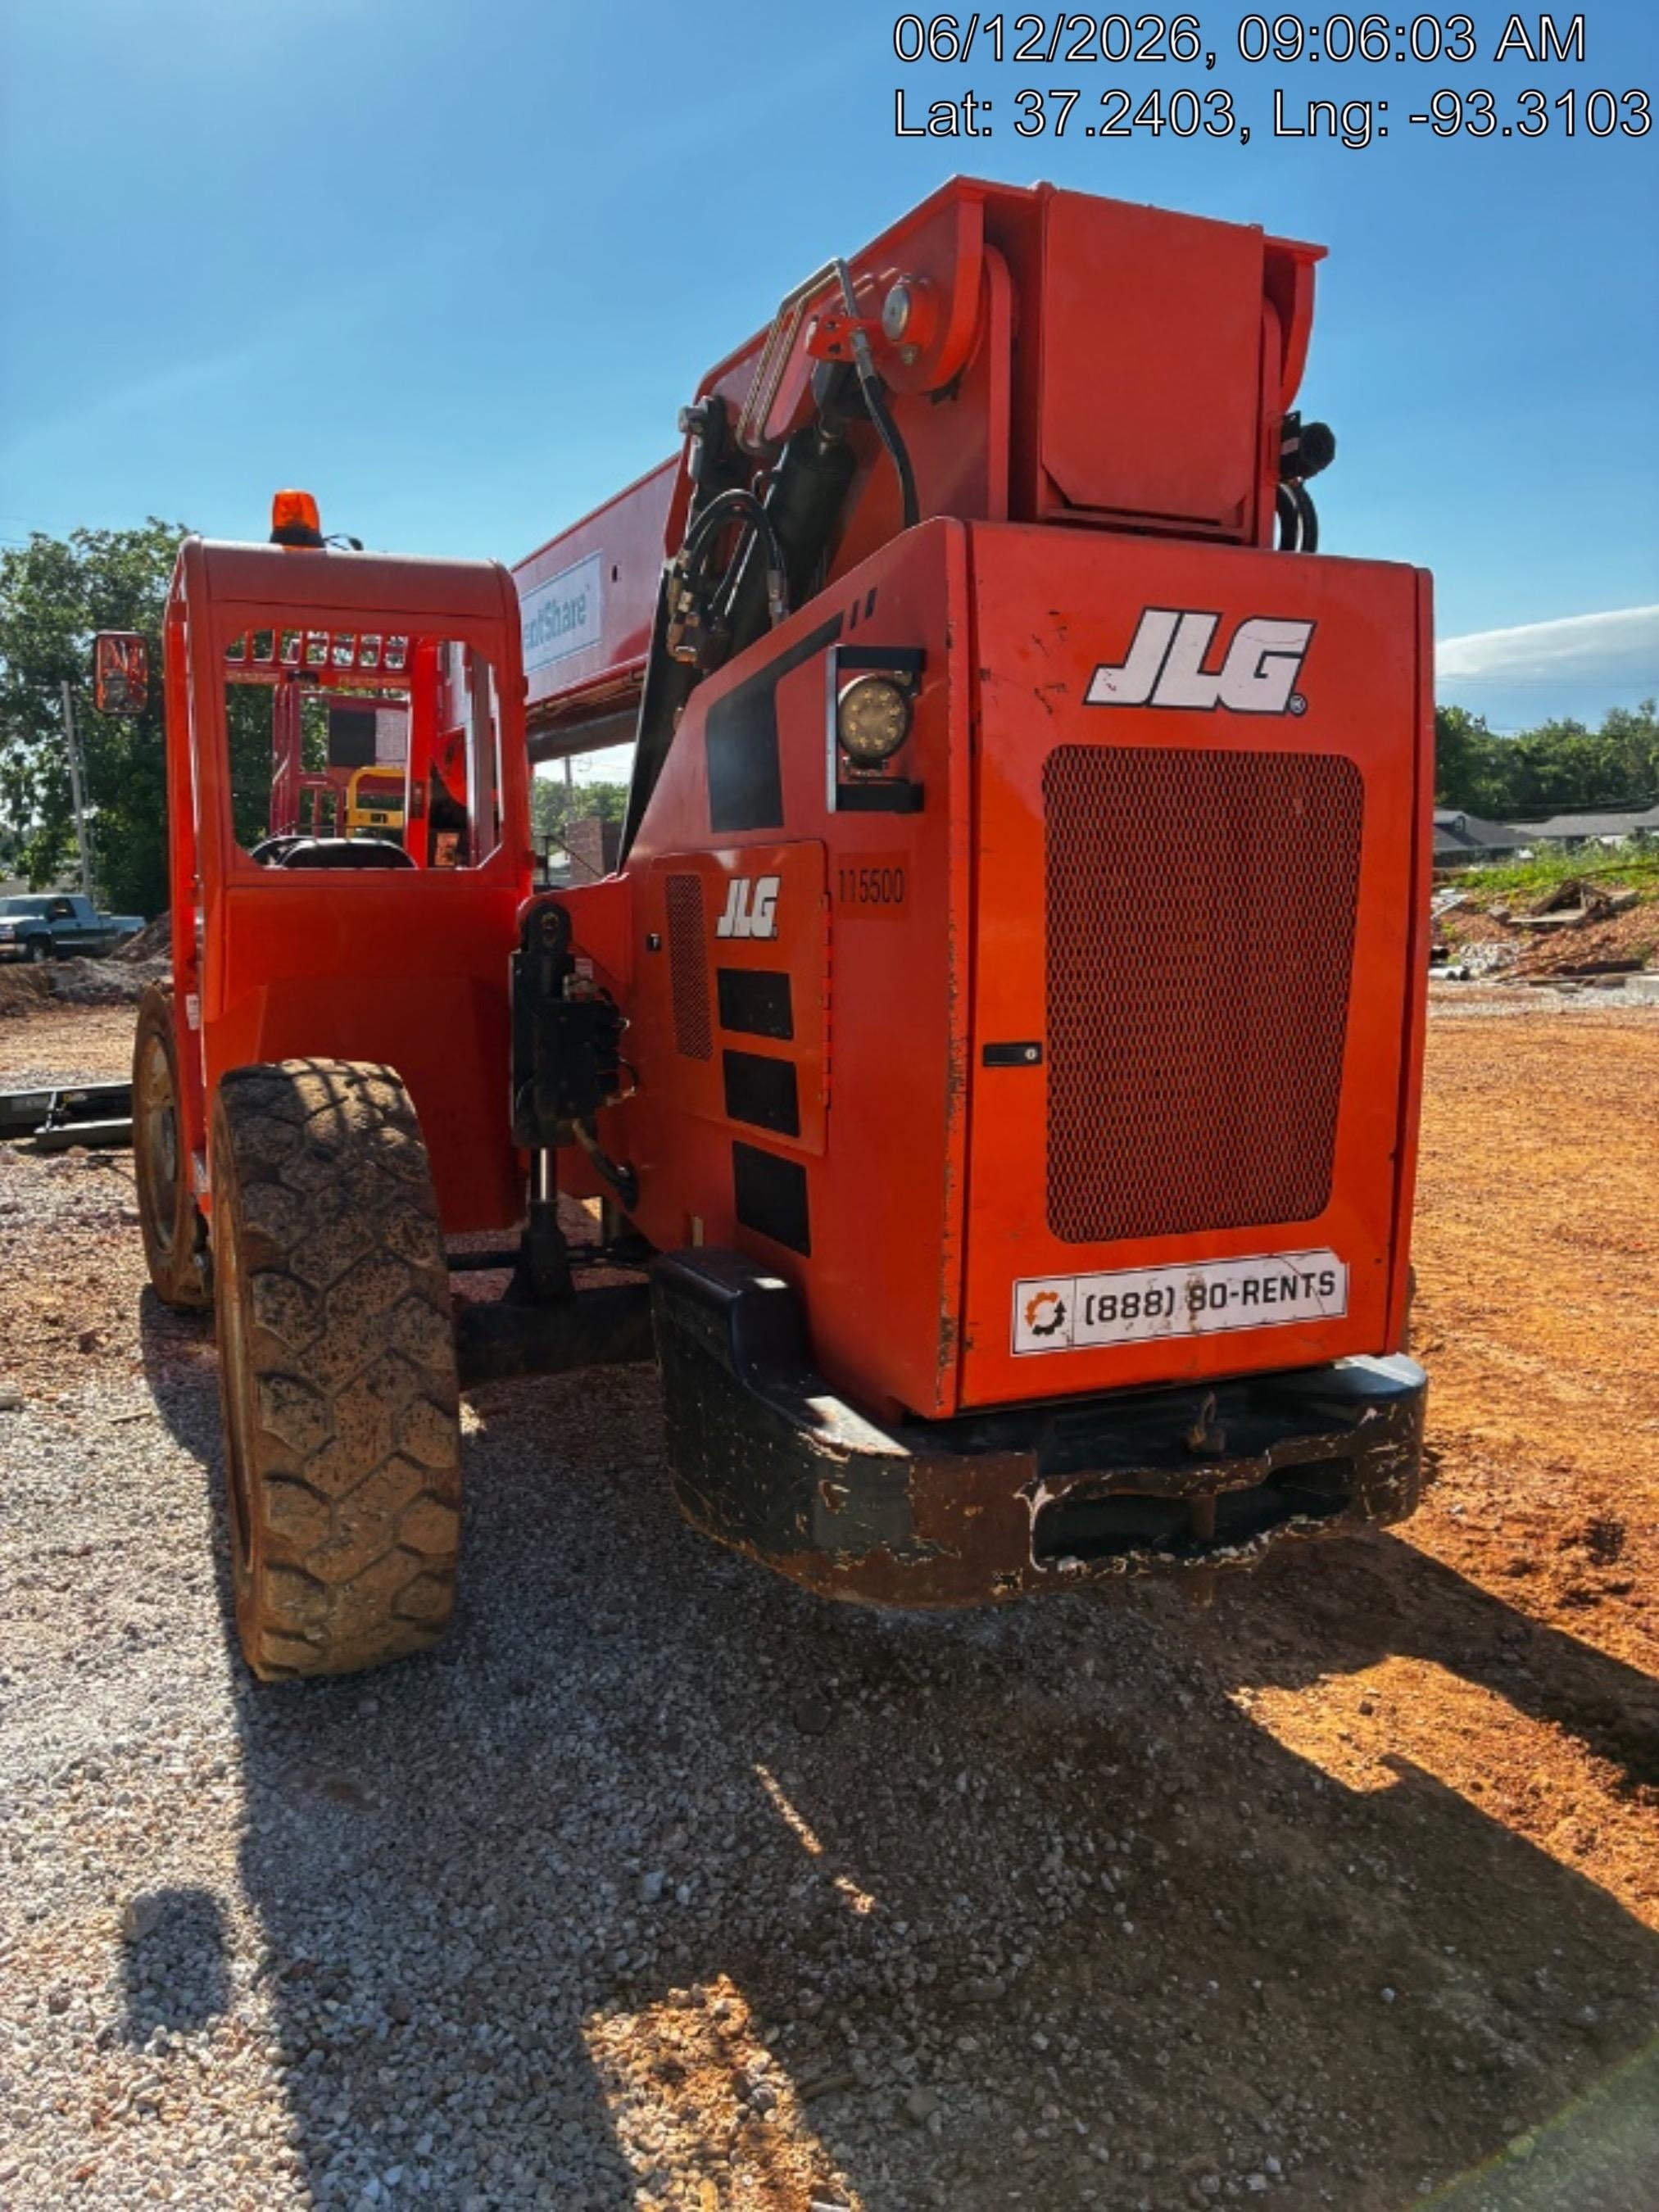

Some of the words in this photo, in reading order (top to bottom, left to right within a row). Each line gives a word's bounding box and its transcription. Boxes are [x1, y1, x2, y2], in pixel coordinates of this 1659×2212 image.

[715, 874, 781, 938] JLG
[838, 867, 904, 904] 115500
[1085, 1286, 1175, 1326] (888)
[1187, 1270, 1336, 1312] 80-RENTS
